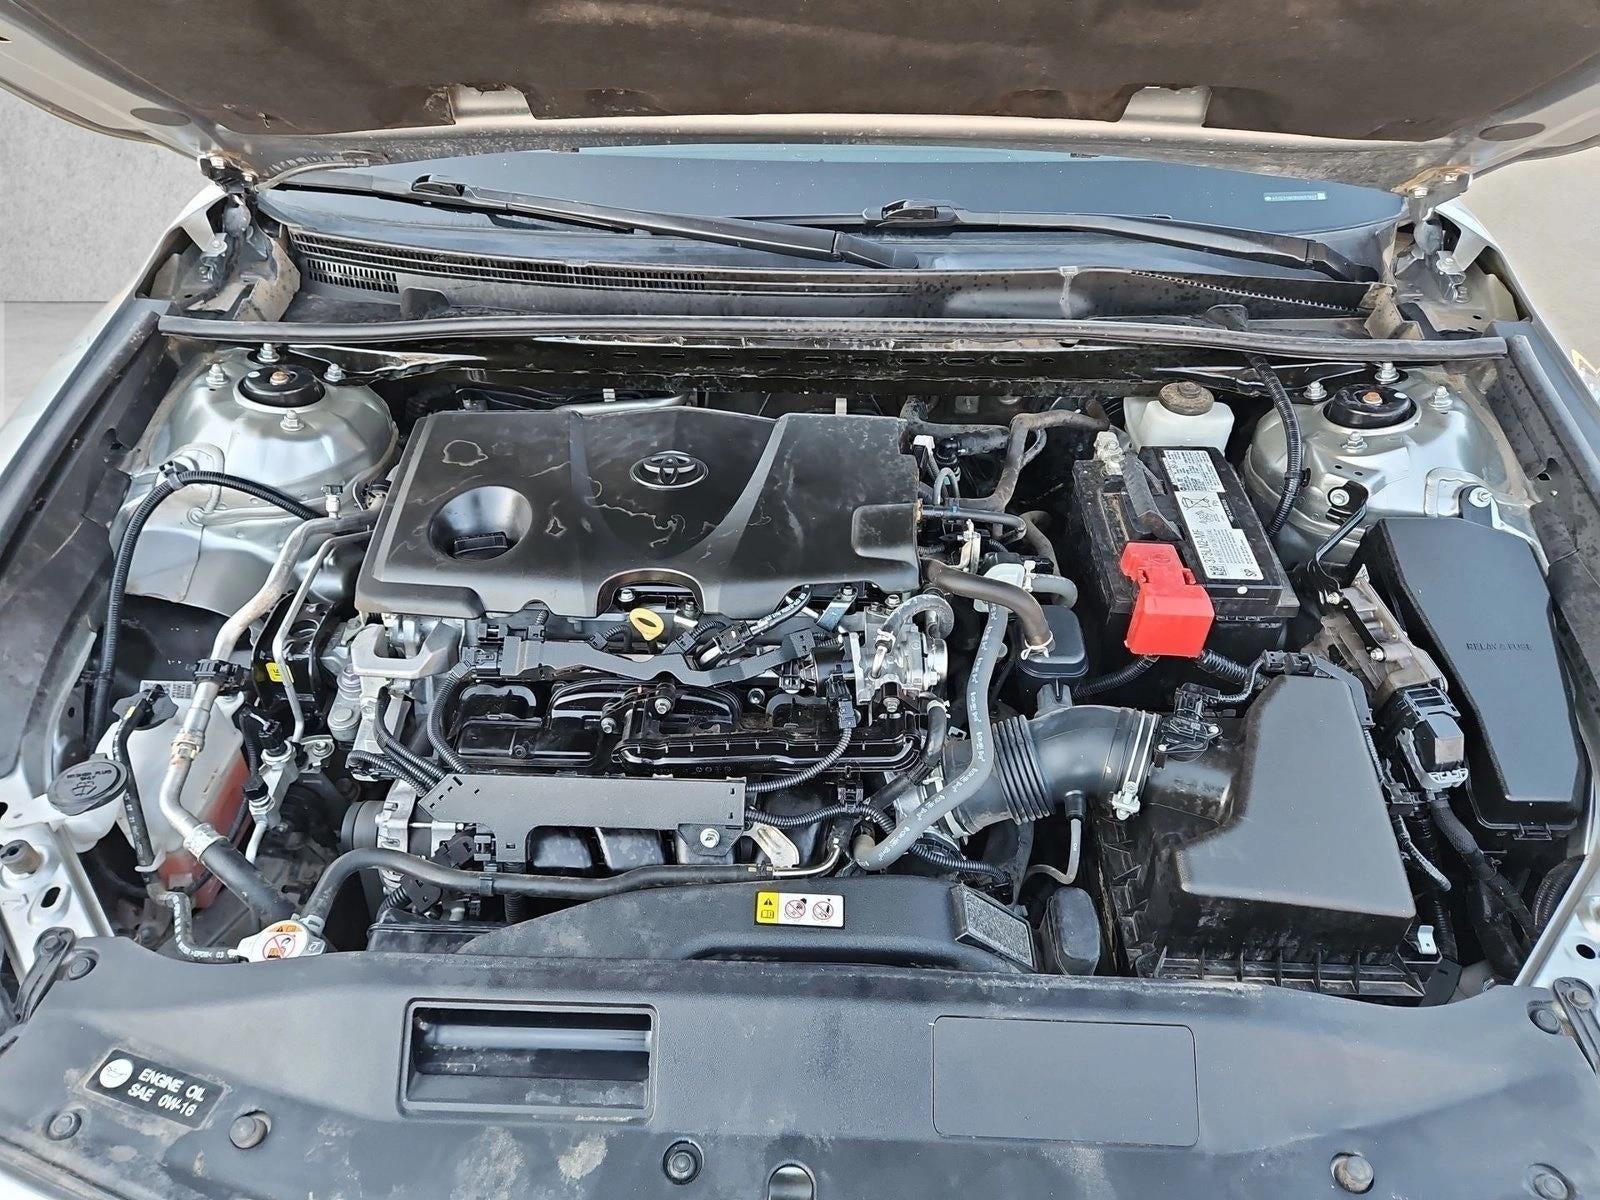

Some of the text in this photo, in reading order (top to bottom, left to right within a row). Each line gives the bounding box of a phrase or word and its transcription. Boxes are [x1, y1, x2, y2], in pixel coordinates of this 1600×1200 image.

[128, 1084, 198, 1117] SAE 0W-16
[138, 1068, 206, 1102] ENGINE OIL
